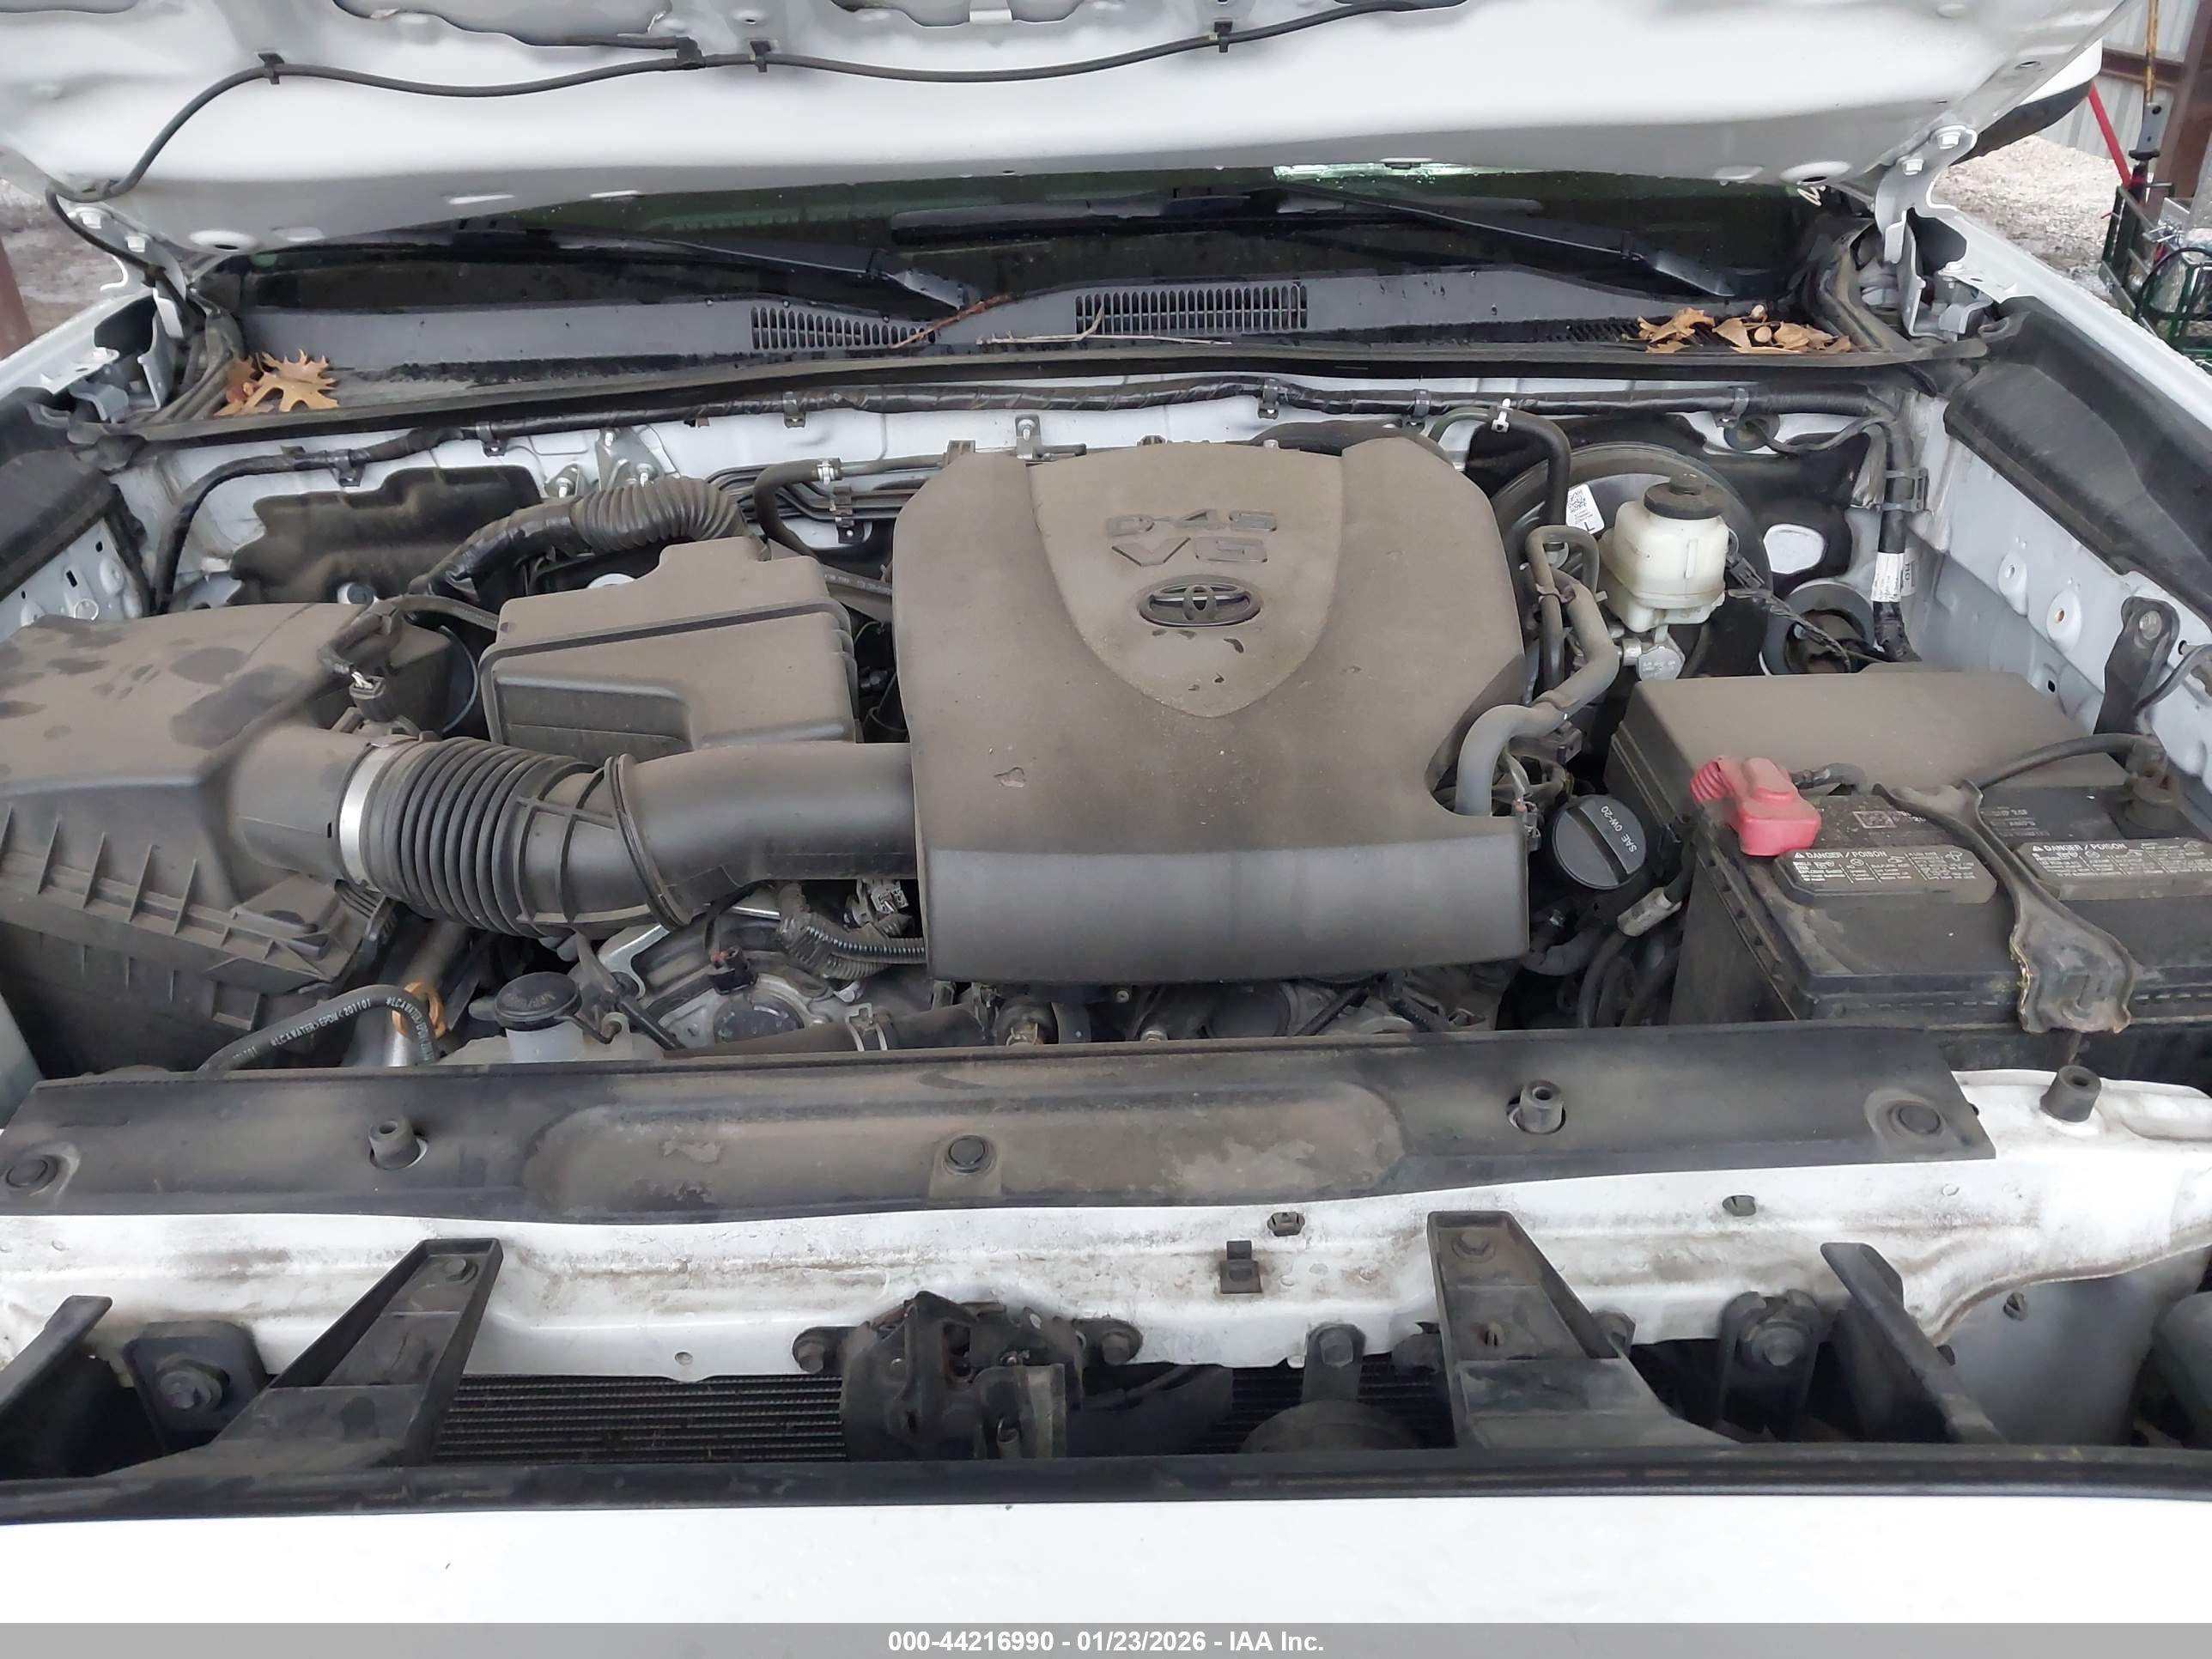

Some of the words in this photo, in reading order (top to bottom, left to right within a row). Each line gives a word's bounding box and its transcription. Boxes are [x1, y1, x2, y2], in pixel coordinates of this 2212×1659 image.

[1583, 521, 1595, 532] L
[1111, 536, 1268, 568] V6
[1601, 805, 1623, 832] 0W-20
[1620, 833, 1638, 853] SAE
